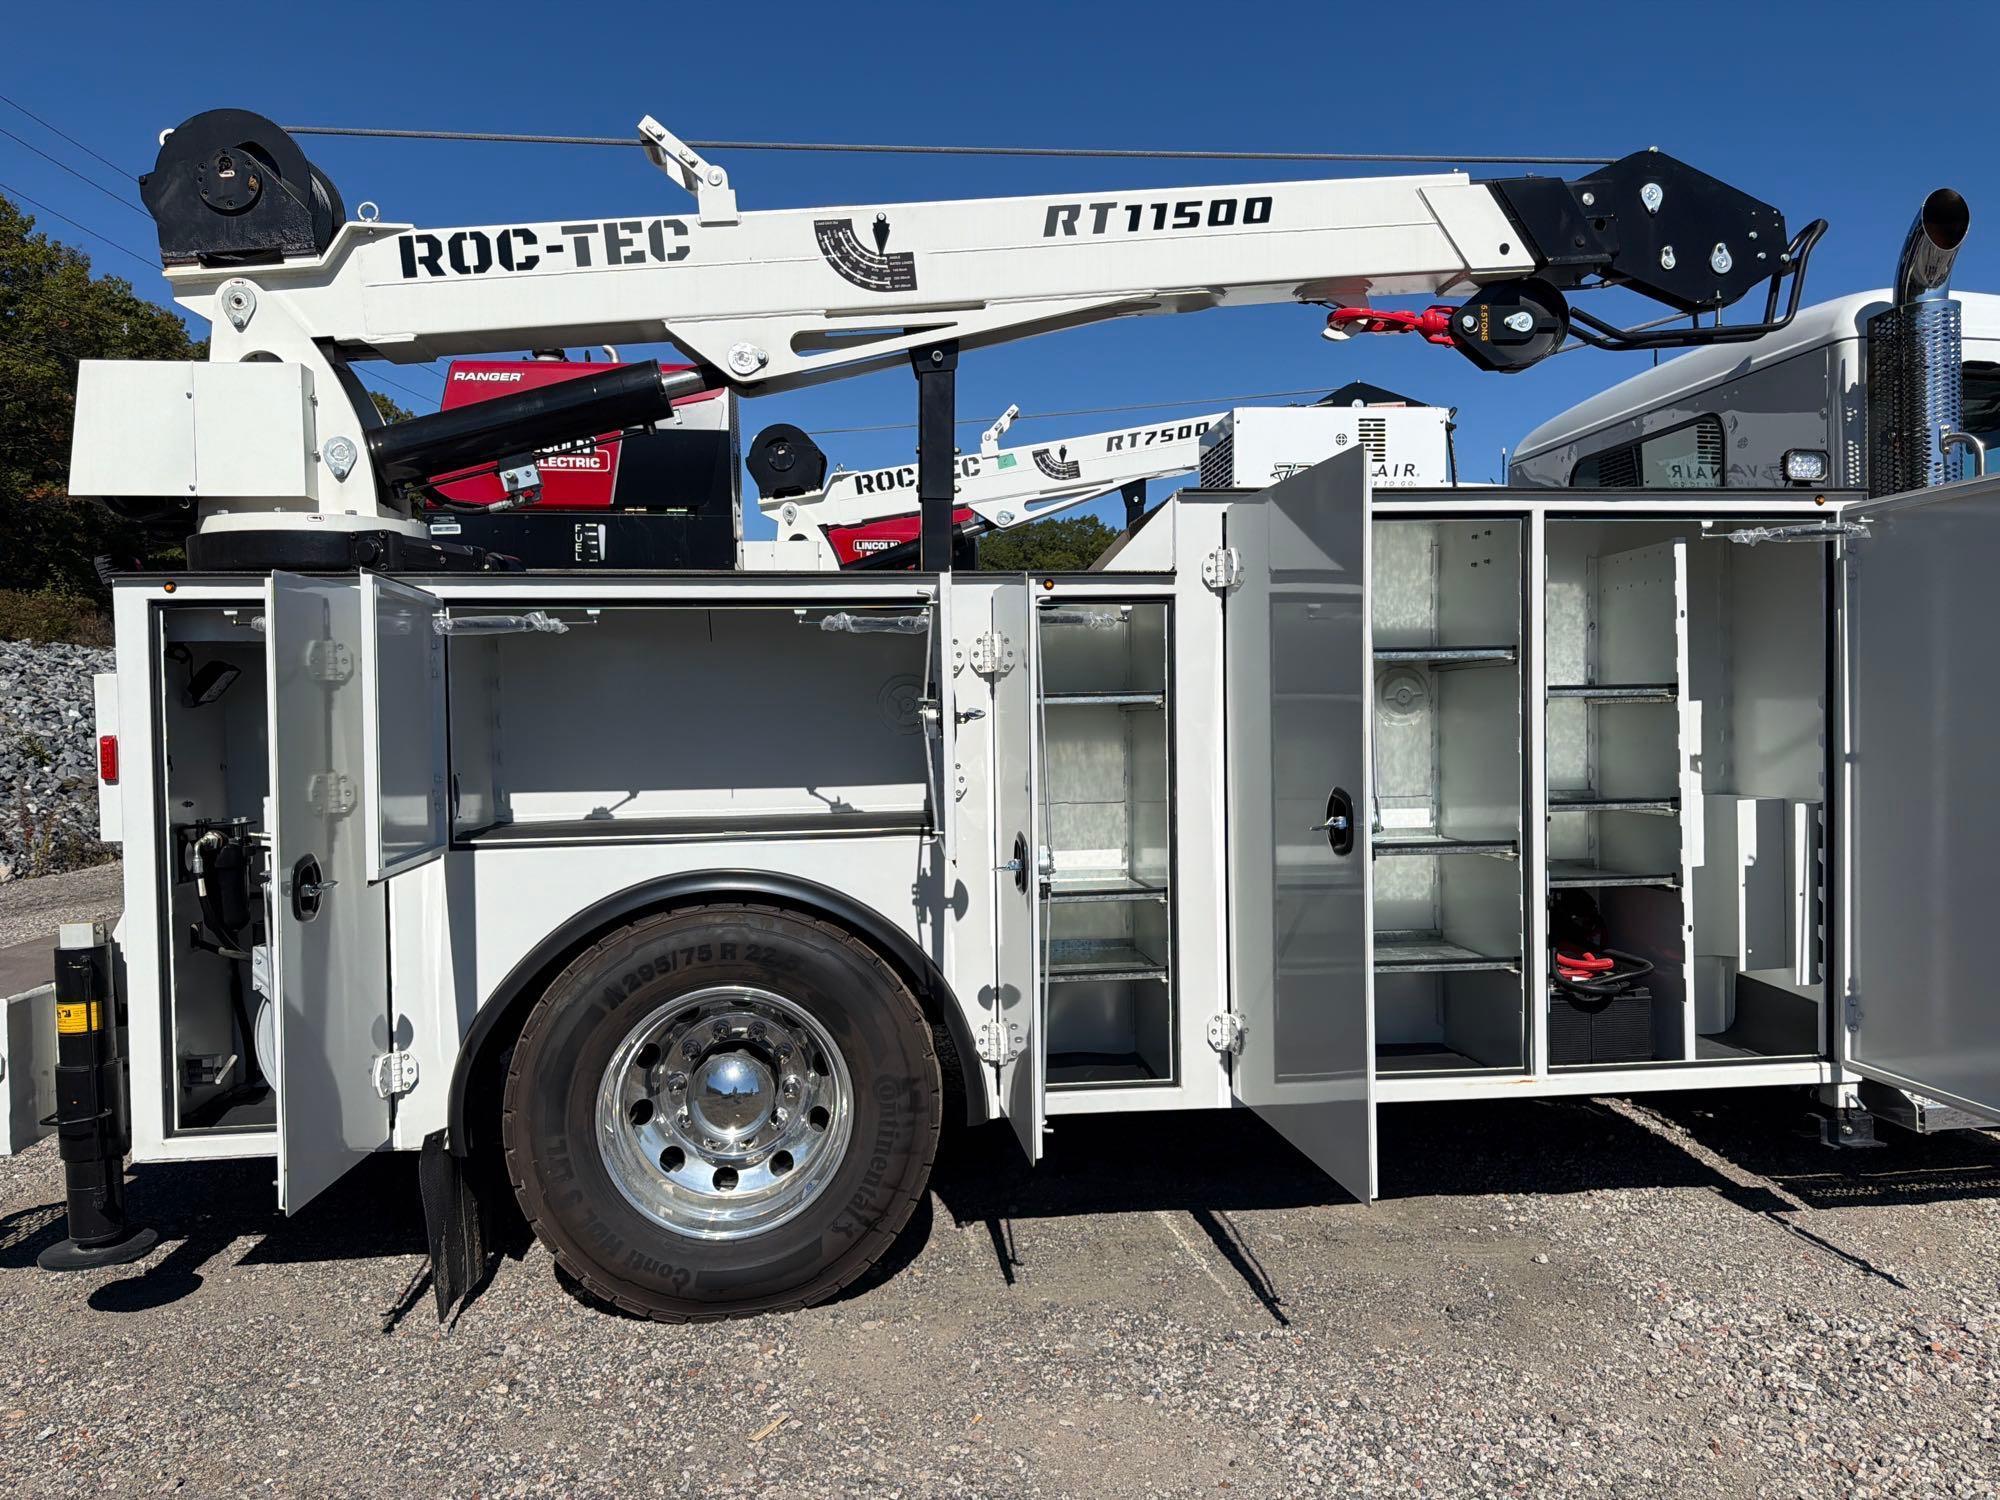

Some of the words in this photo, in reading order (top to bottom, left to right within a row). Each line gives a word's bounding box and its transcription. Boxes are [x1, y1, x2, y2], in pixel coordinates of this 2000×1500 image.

[1043, 196, 1273, 237] RT11500
[399, 218, 691, 279] ROC-TEC
[454, 371, 522, 382] RANGER
[1106, 422, 1209, 453] RT7500
[535, 456, 601, 469] LECTRIC
[574, 523, 583, 561] FUEL
[856, 541, 898, 550] LINCOLN
[719, 942, 737, 960] R
[845, 1073, 901, 1221] Continental
